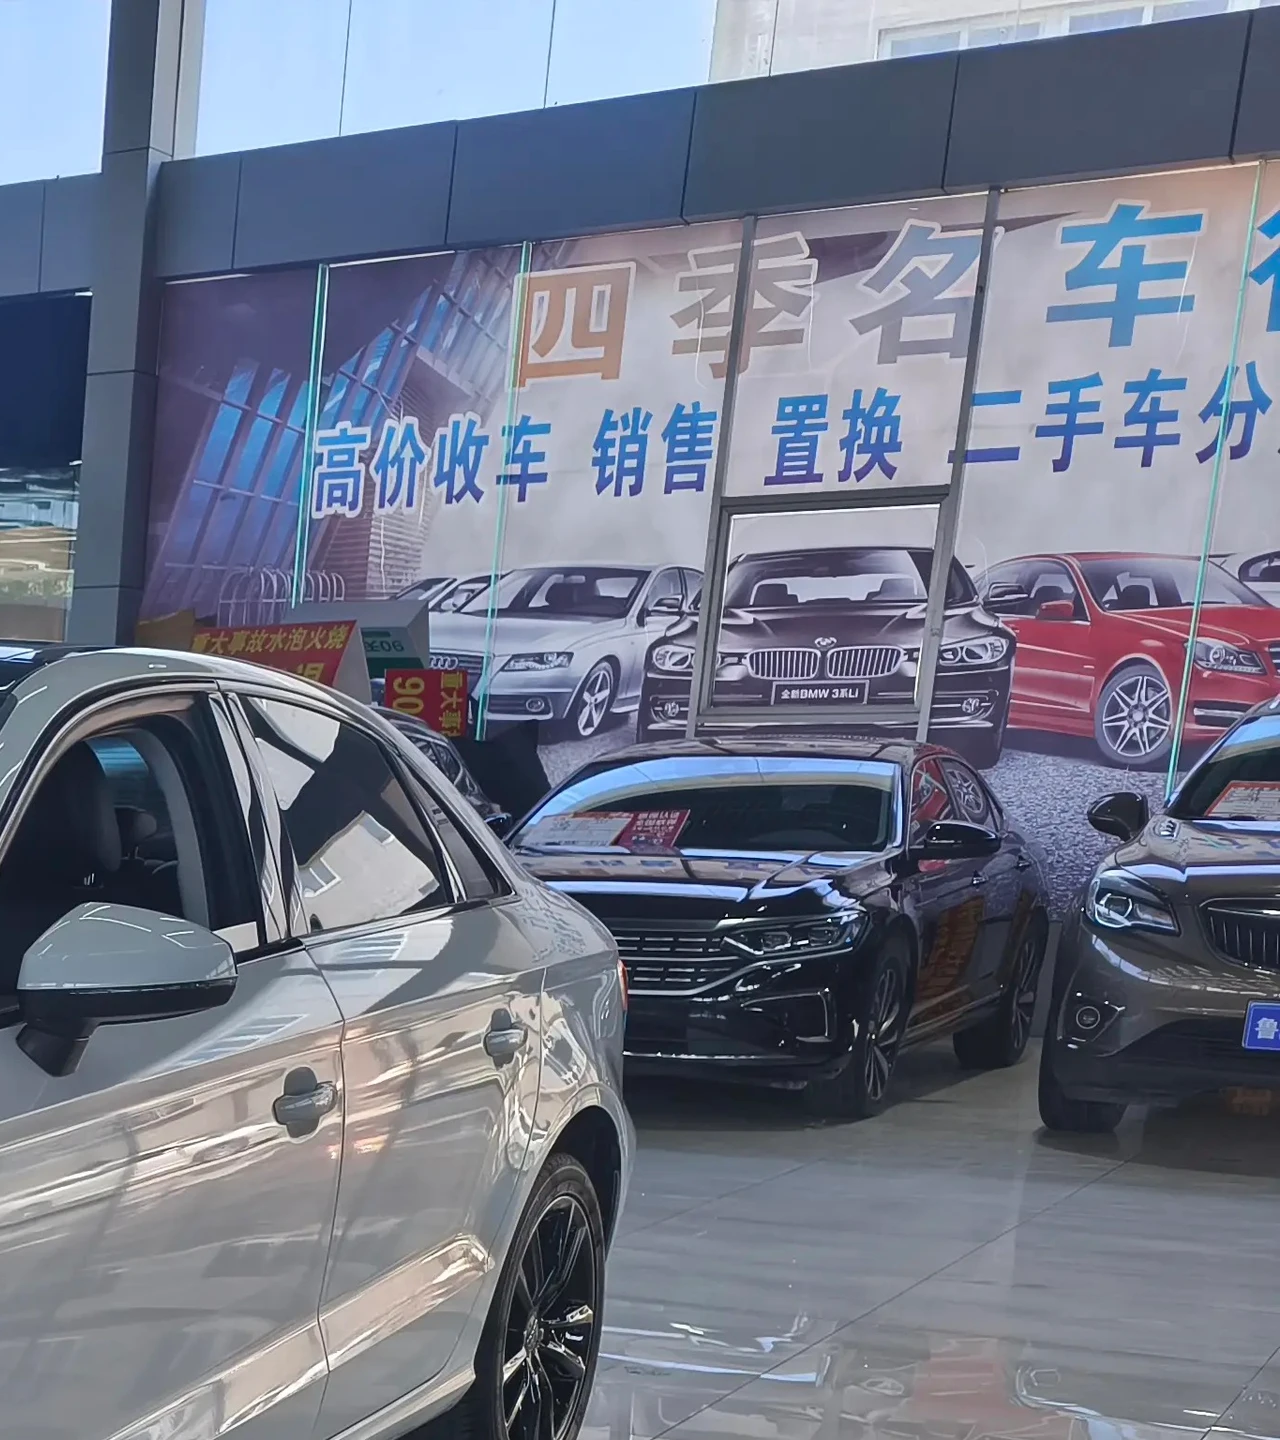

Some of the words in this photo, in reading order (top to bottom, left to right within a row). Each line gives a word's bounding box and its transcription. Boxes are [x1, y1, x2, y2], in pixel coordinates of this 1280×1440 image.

[514, 203, 1280, 388] 四季名车
[315, 414, 552, 513] 高价收车
[591, 400, 718, 498] 销售
[763, 386, 903, 487] 置换
[191, 624, 350, 655] 重大事故水泡火烧
[1254, 1017, 1279, 1039] 鲁
